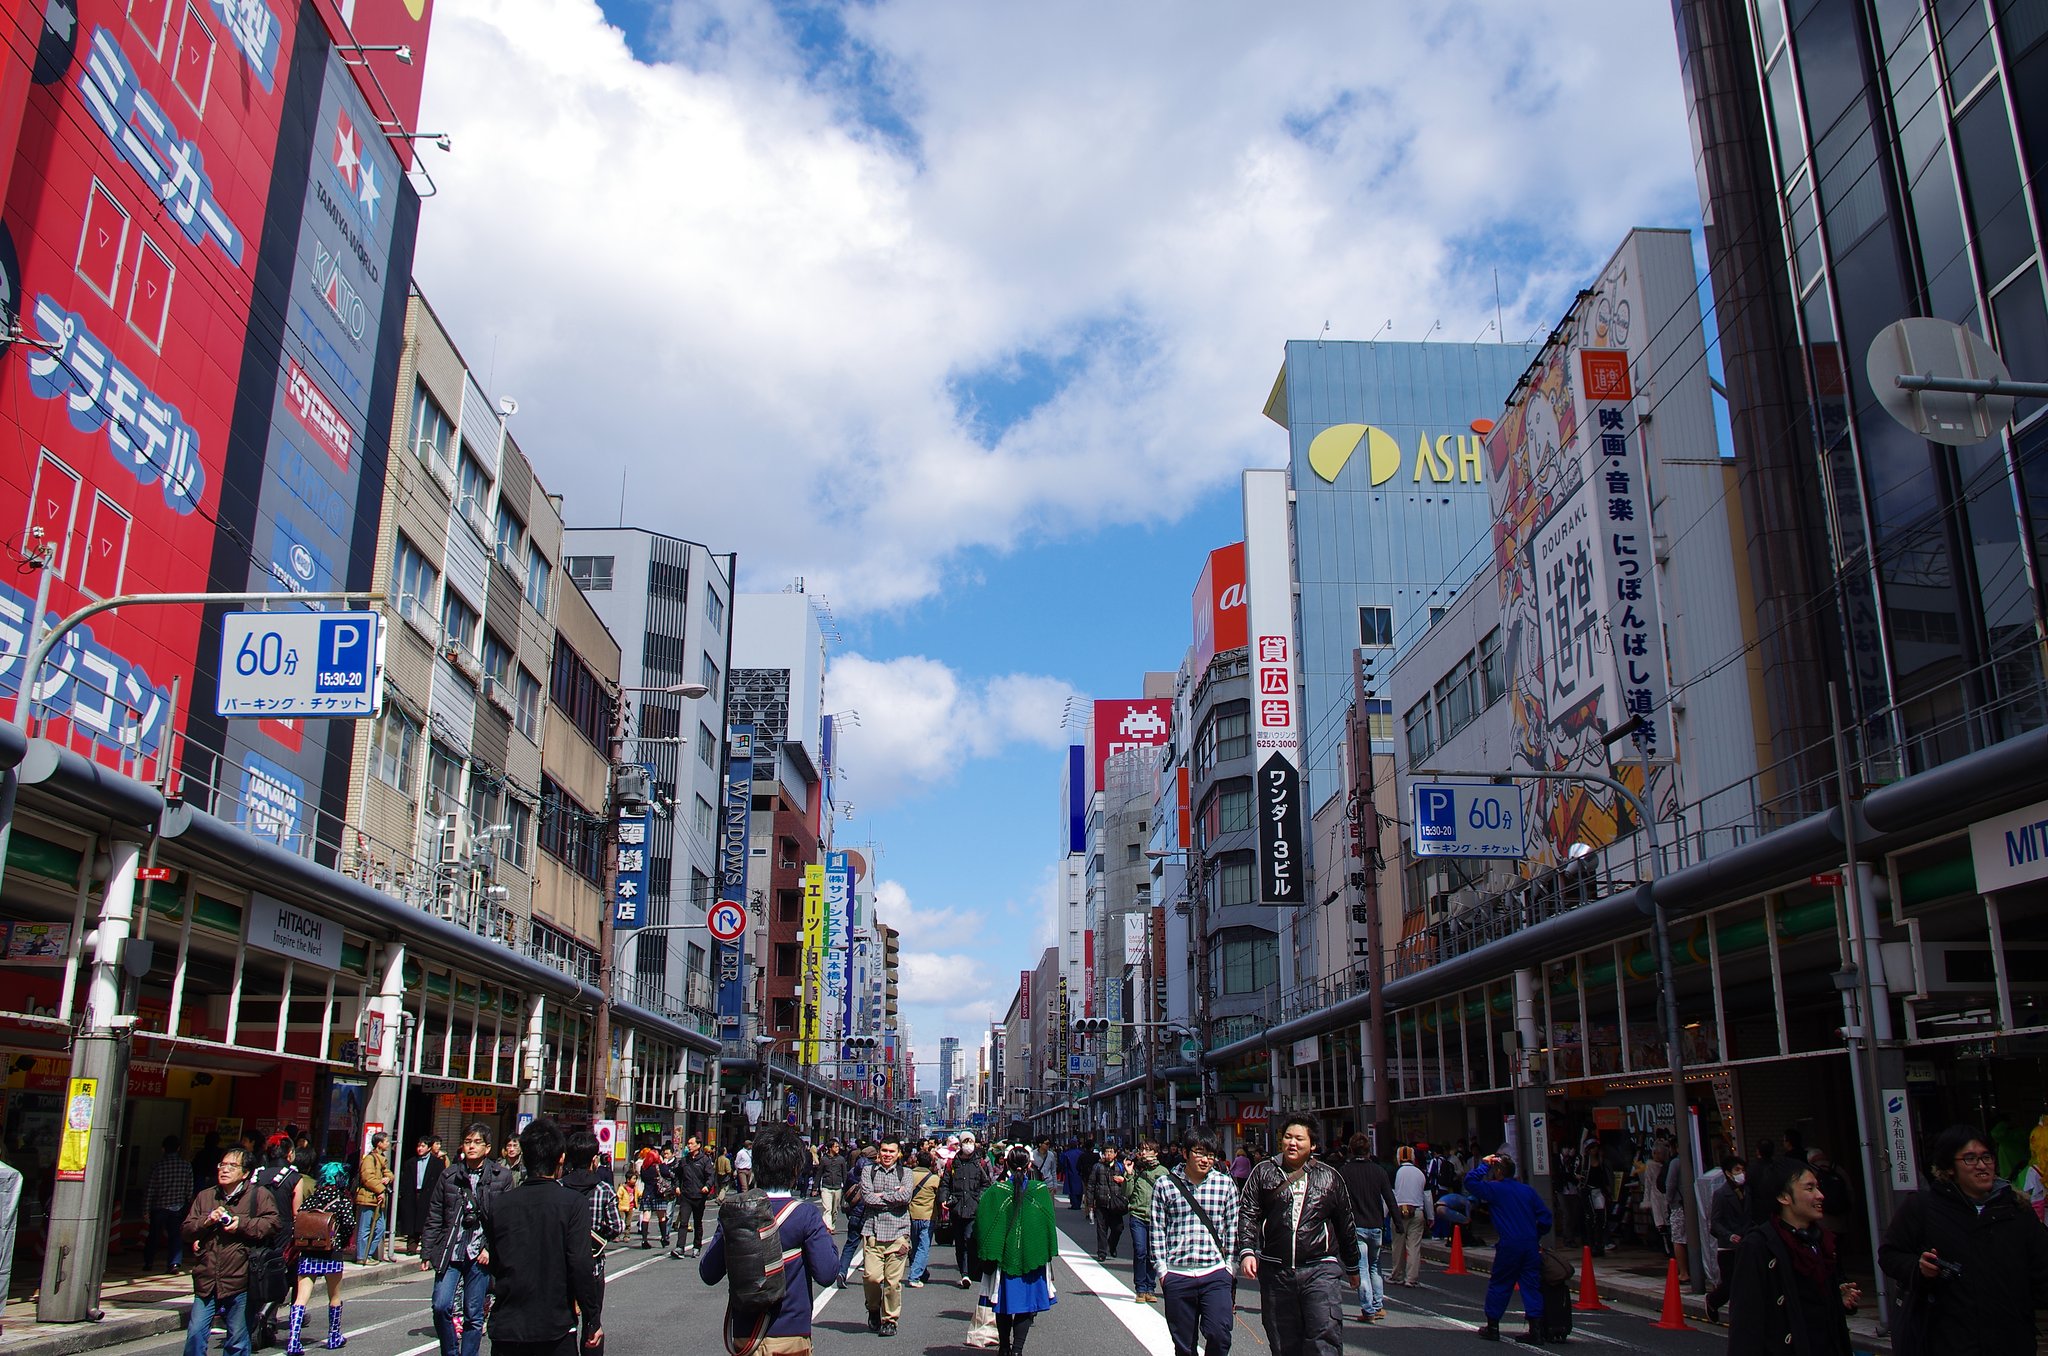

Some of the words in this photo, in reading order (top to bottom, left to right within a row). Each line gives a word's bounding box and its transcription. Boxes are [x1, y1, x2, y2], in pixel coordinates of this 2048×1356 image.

[82, 29, 233, 249] ミニカー
[316, 180, 349, 242] TAMIYA
[349, 230, 379, 283] WORLD
[312, 241, 366, 340] KATO
[30, 300, 195, 496] プラモデル
[1594, 368, 1620, 391] 道楽
[1599, 407, 1634, 521] 映画・音楽
[236, 632, 299, 676] 60分
[332, 625, 360, 665] P
[319, 672, 362, 686] 15:30-20
[1260, 637, 1288, 726] 貸広告
[224, 697, 367, 710] パーキング・チケット
[1257, 740, 1297, 748] 6252-3000
[249, 766, 297, 813] TAKARA
[1422, 826, 1452, 836] 15:30-20
[1429, 793, 1448, 821] P
[1469, 798, 1512, 830] 60分
[725, 778, 749, 888] WINDOWS
[1270, 770, 1291, 896] ワンダー3ビル
[1422, 843, 1520, 854] パーキング・チケット
[273, 930, 295, 948] Inspire
[297, 939, 307, 952] the
[307, 941, 322, 957] Next
[278, 909, 322, 941] HITACHI
[825, 1011, 833, 1050] J.Bride
[466, 1087, 493, 1097] DVD
[1656, 1103, 1675, 1117] USED
[1892, 1116, 1909, 1183] 永和信用金庫
